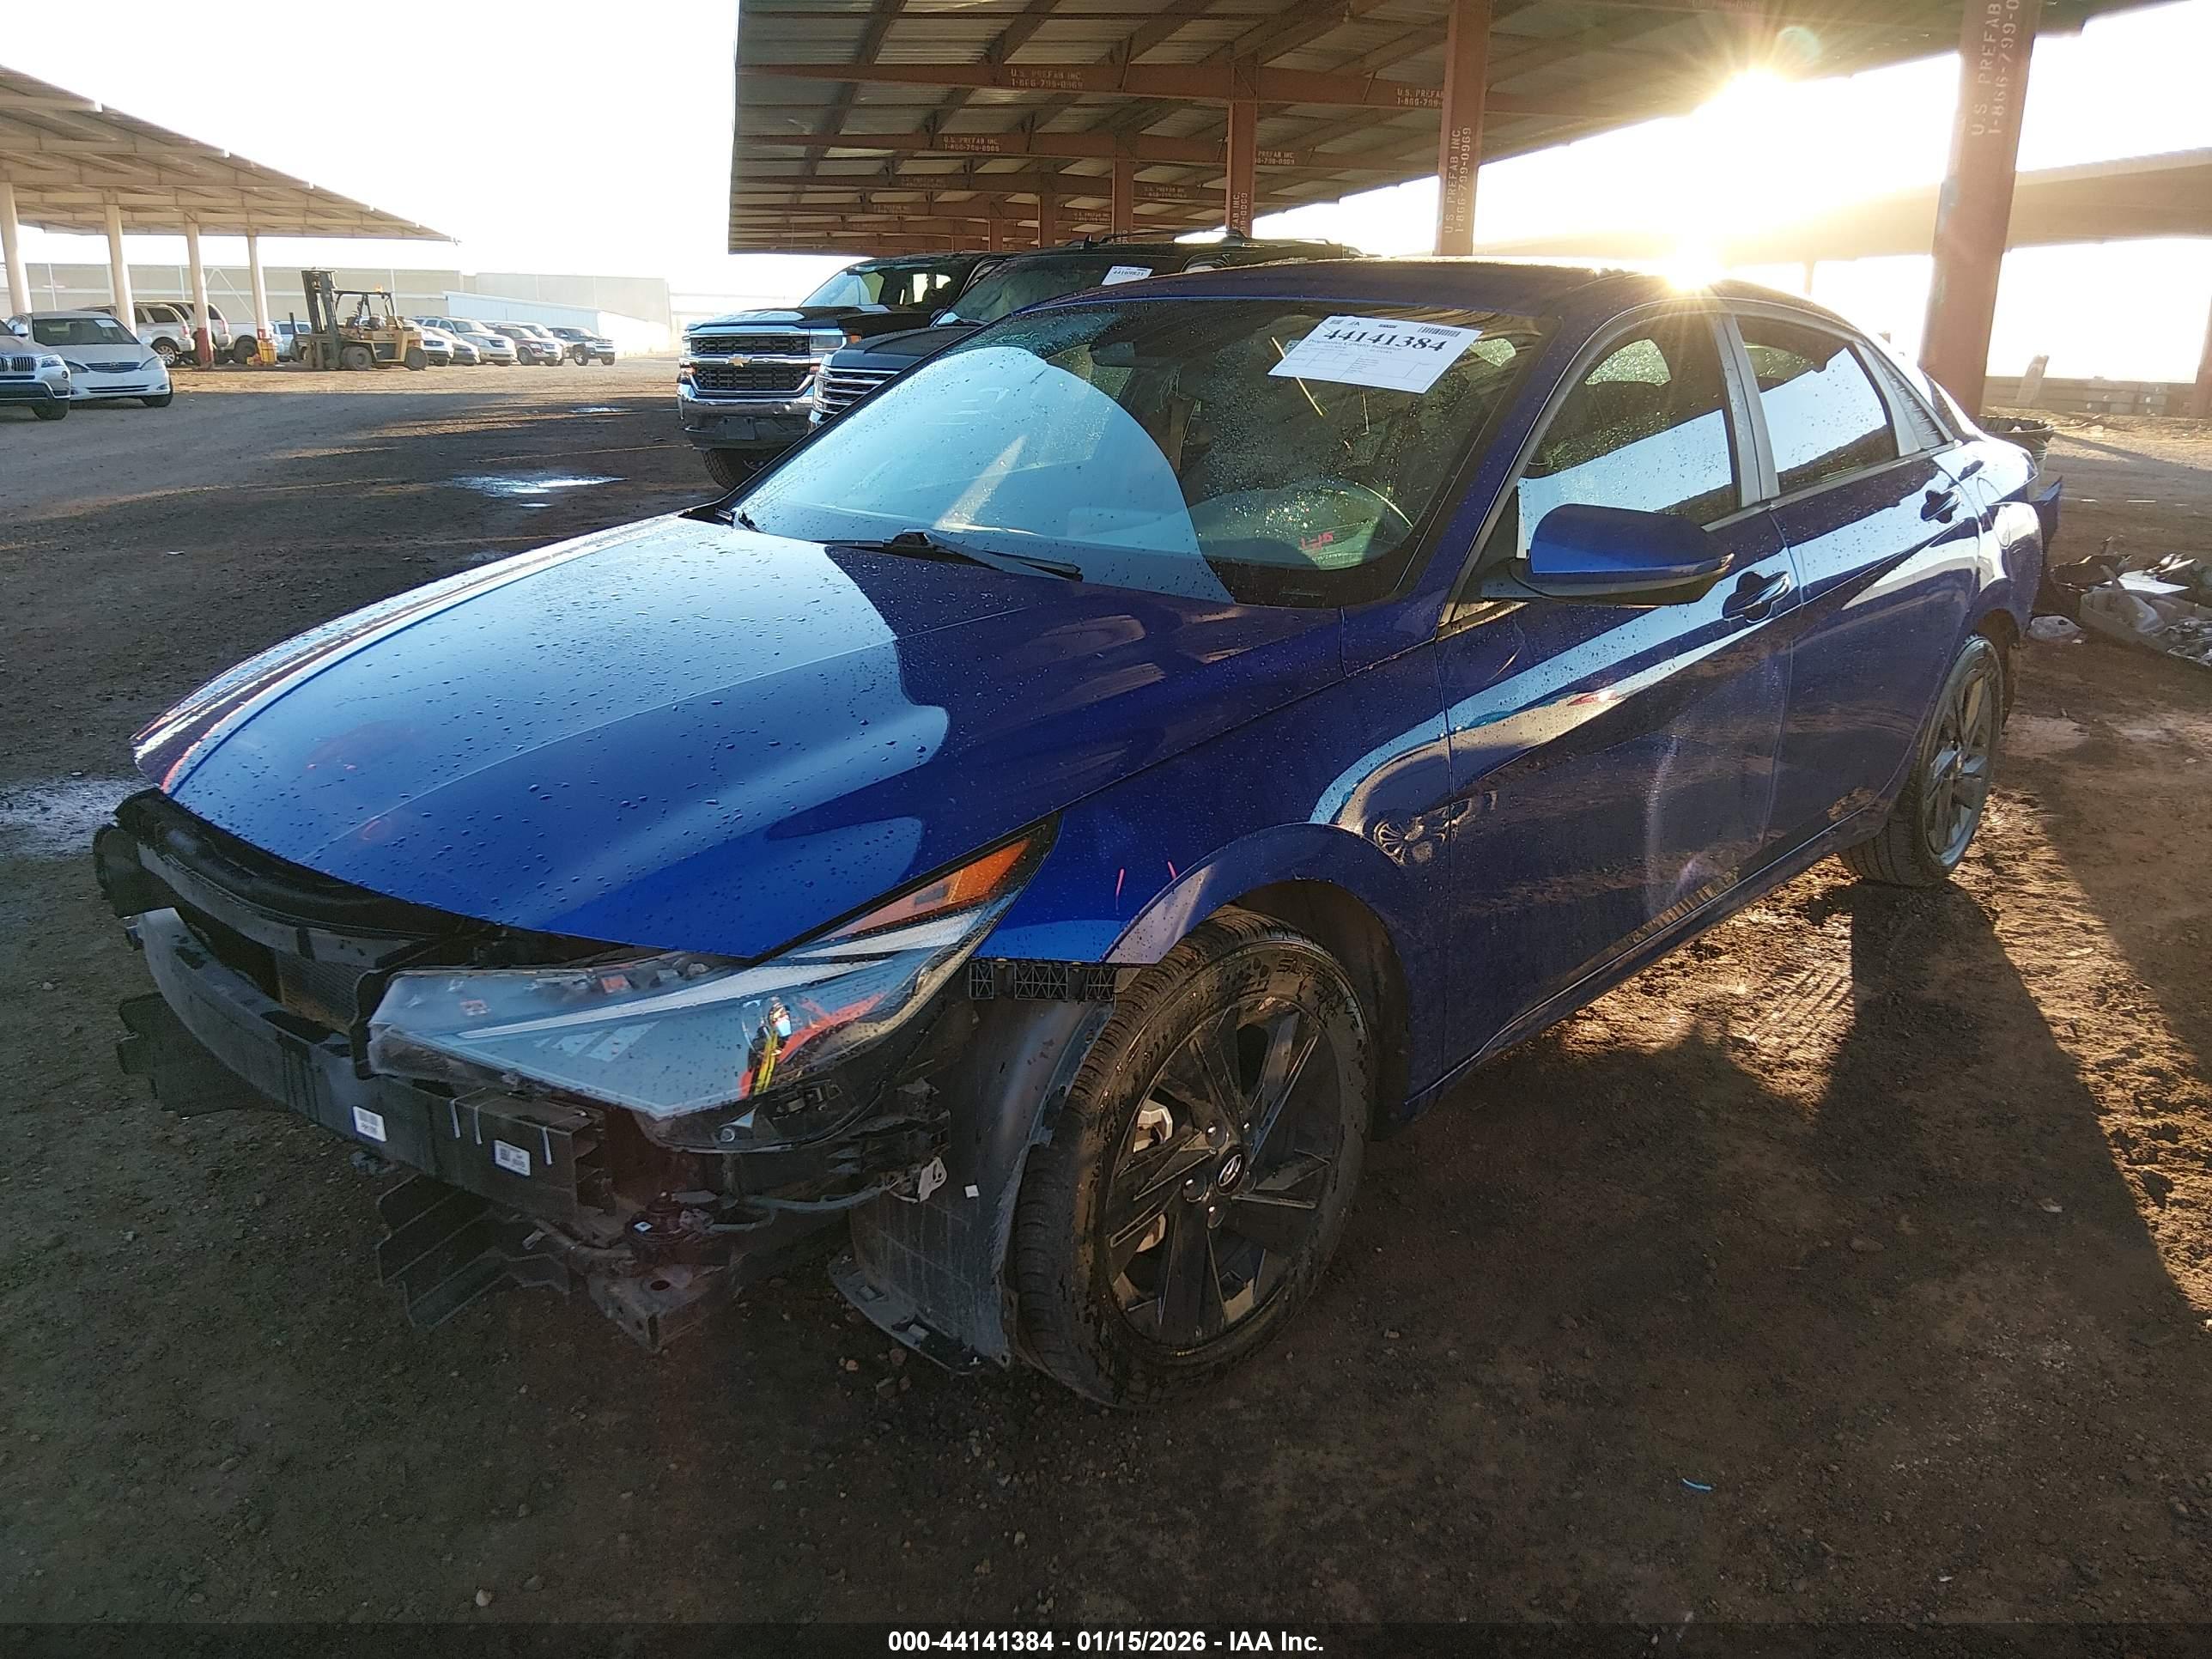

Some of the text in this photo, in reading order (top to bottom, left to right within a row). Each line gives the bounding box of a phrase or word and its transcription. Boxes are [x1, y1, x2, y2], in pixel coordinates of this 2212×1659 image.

[1978, 3, 2002, 83] PREFAB
[1446, 155, 1459, 204] PREFAB
[1323, 329, 1448, 352] 44141384
